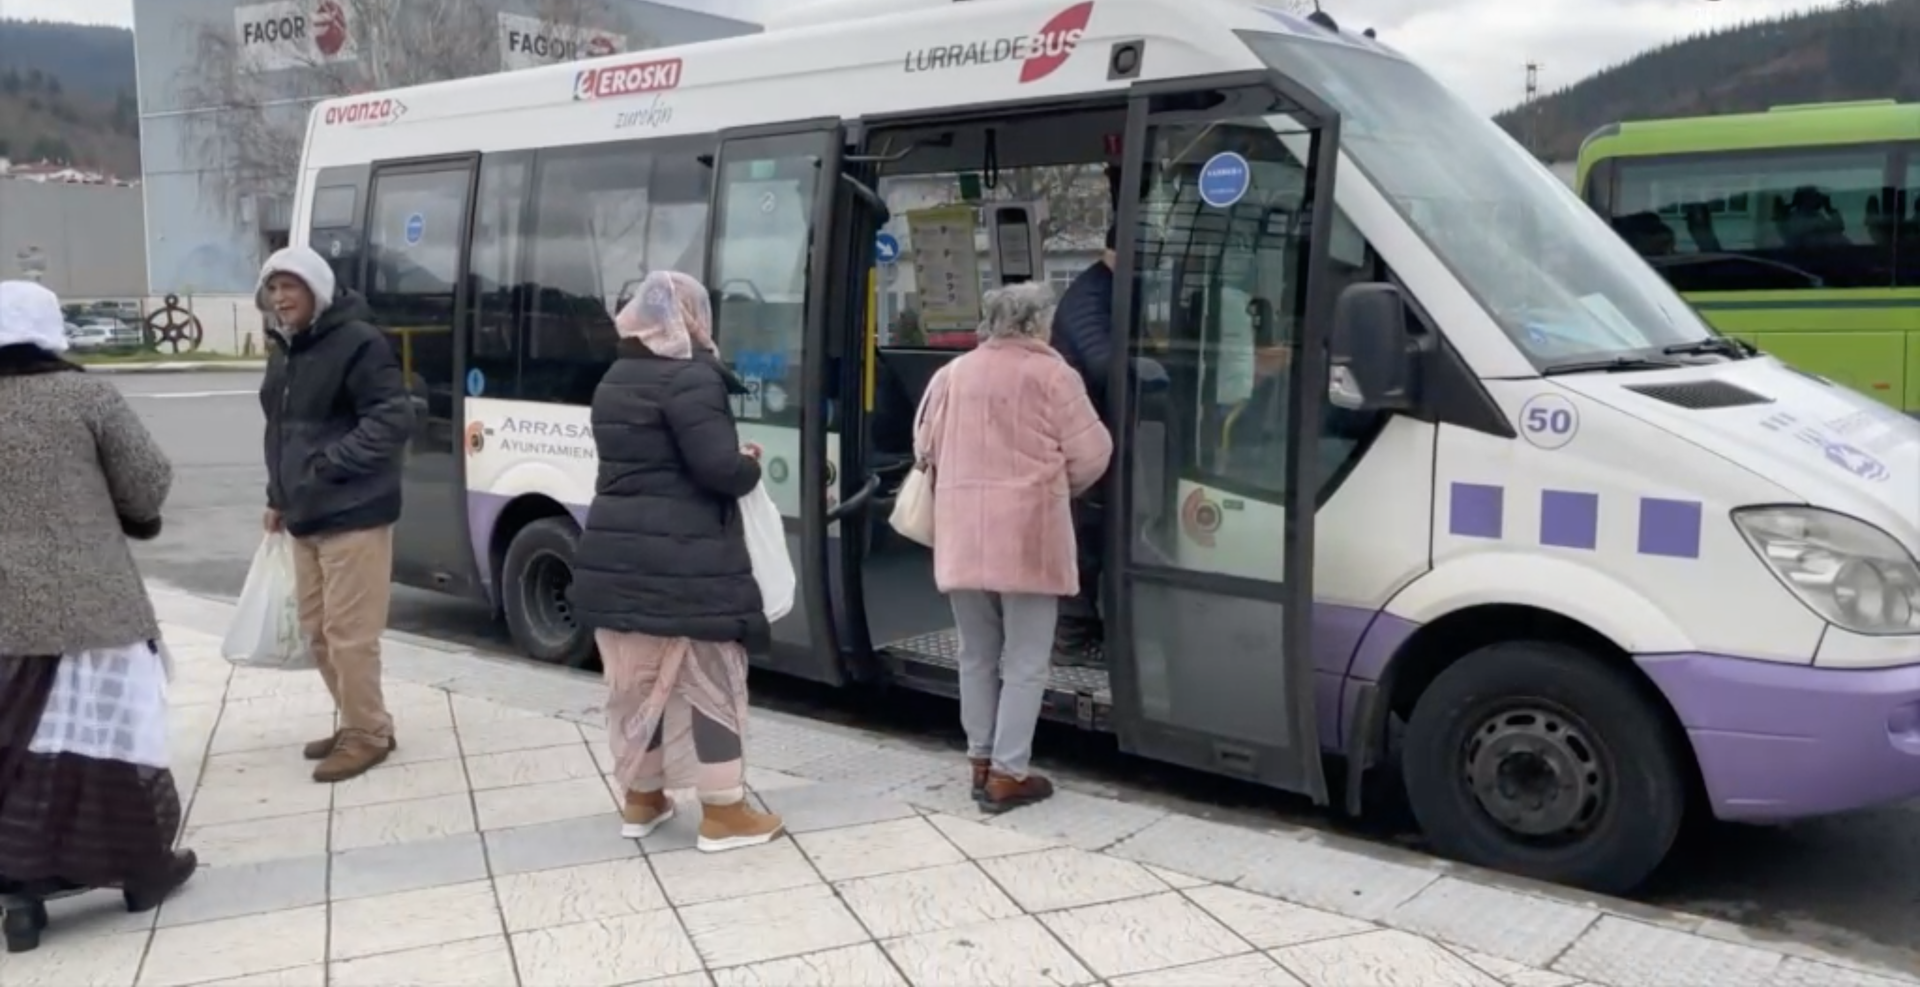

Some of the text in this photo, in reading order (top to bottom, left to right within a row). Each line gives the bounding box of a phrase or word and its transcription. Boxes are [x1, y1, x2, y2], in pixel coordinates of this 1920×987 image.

[243, 16, 306, 46] FAGOR
[599, 61, 679, 95] EROSKI
[325, 99, 392, 125] avanza
[1526, 407, 1571, 434] 50
